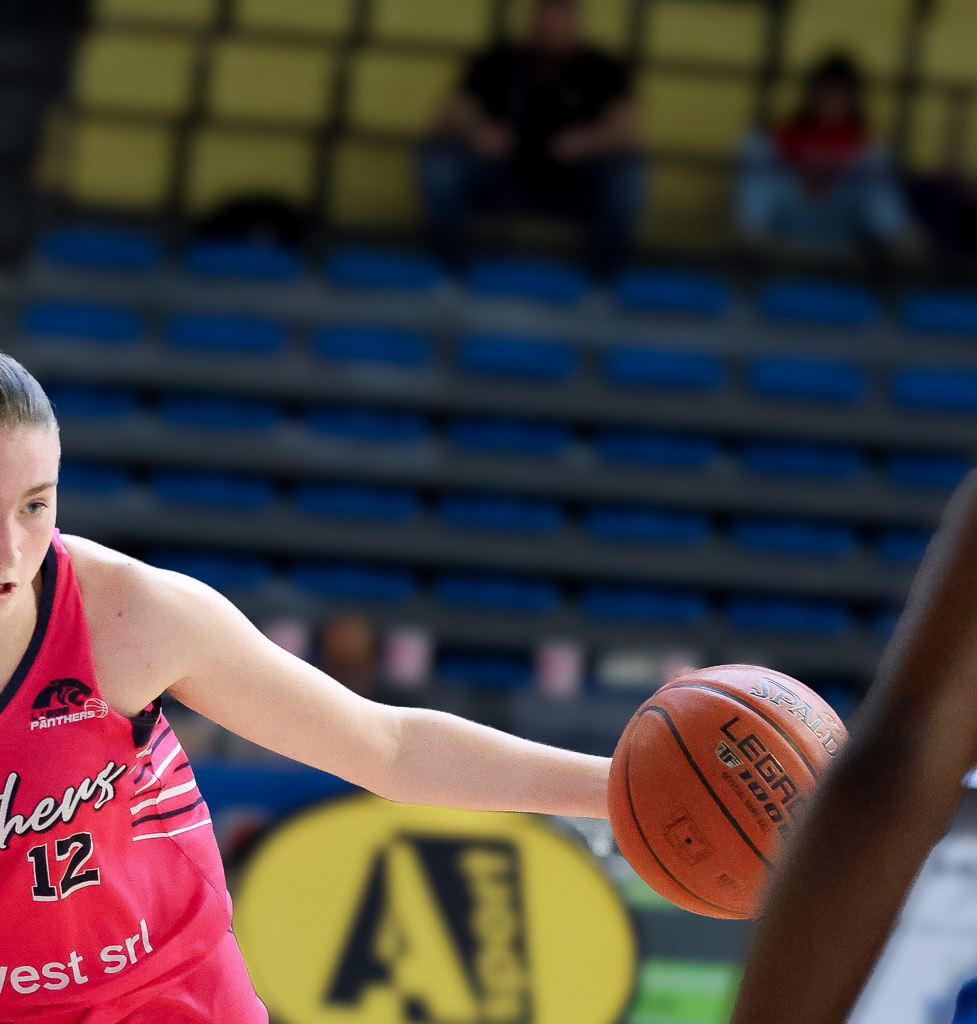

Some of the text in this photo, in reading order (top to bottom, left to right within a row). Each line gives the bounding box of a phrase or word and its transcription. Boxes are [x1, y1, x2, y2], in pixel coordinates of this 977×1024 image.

[750, 677, 840, 758] SPALD
[719, 715, 800, 815] LEGA
[27, 832, 101, 902] 12
[100, 918, 154, 974] srl
